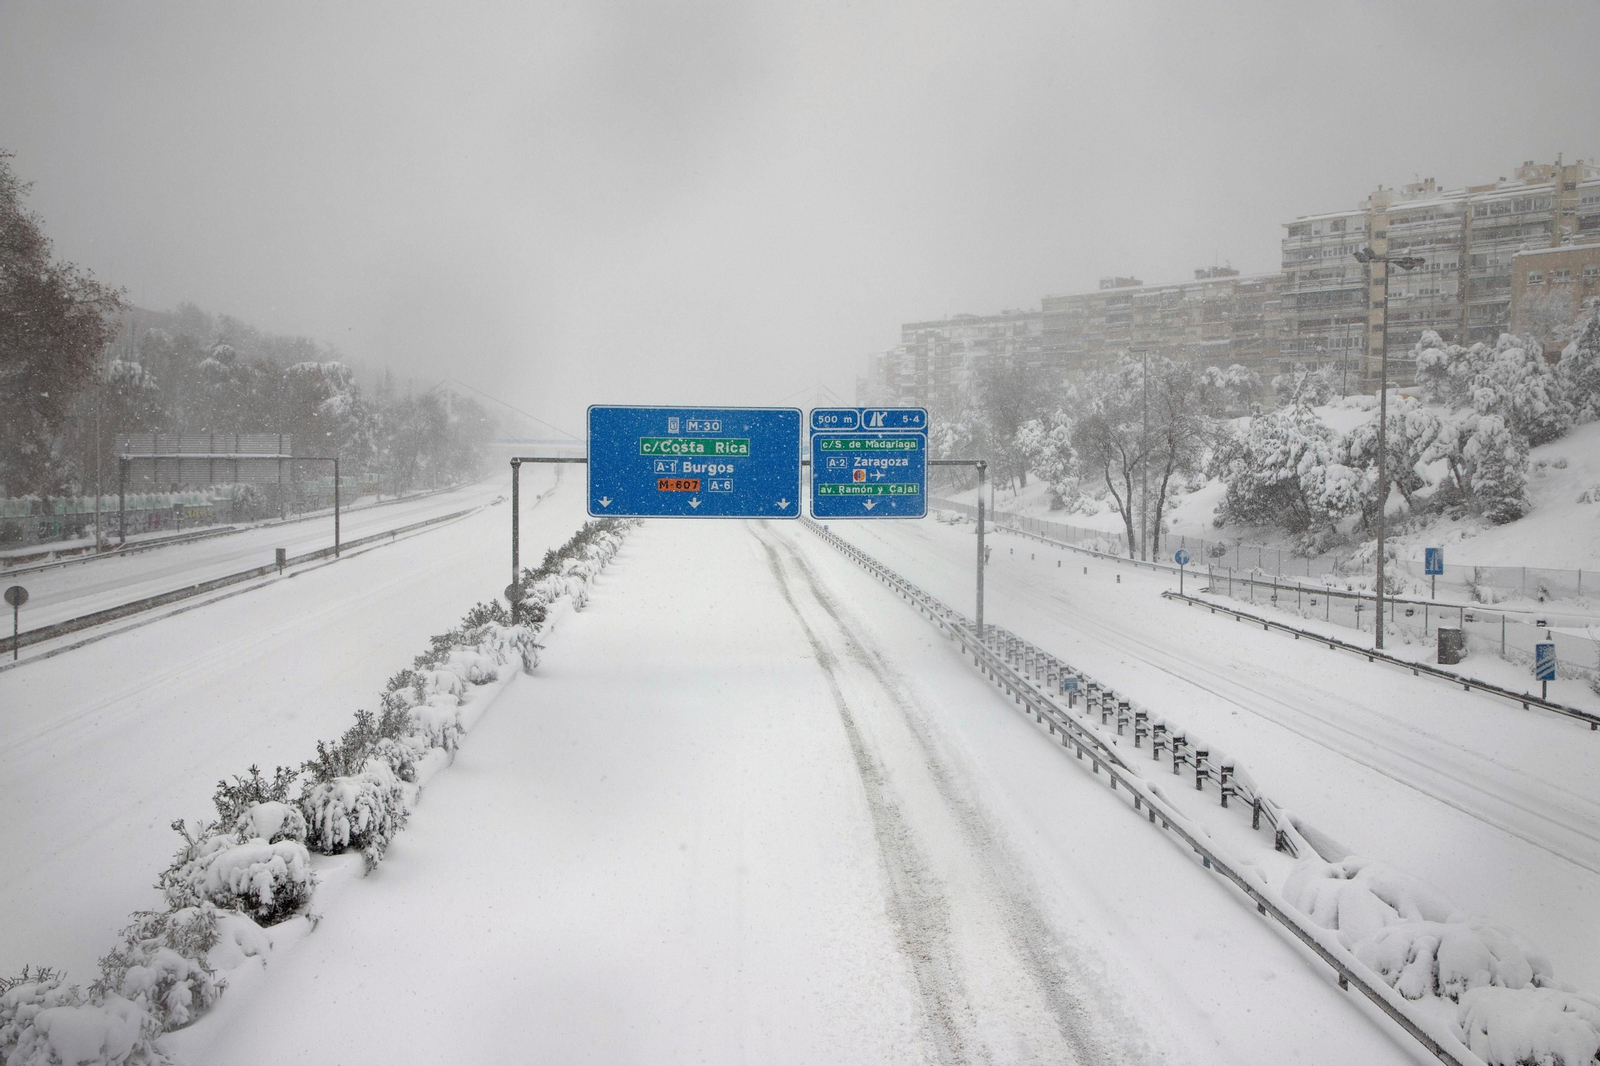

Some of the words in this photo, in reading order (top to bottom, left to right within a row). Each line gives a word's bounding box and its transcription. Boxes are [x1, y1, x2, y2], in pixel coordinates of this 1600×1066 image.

[818, 416, 839, 424] 500
[688, 422, 720, 430] M-30
[643, 441, 704, 452] c/Costa
[715, 442, 747, 453] Rica
[823, 441, 846, 449] c/S.
[849, 441, 862, 449] de
[866, 441, 916, 450] Madariaga
[829, 459, 846, 467] A-2
[854, 457, 908, 468] Zaragoza
[656, 463, 676, 472] A-1
[683, 462, 734, 475] Burgos
[659, 481, 698, 489] M-607
[711, 481, 731, 490] A-6
[877, 486, 884, 495] y
[889, 485, 917, 494] Cajal
